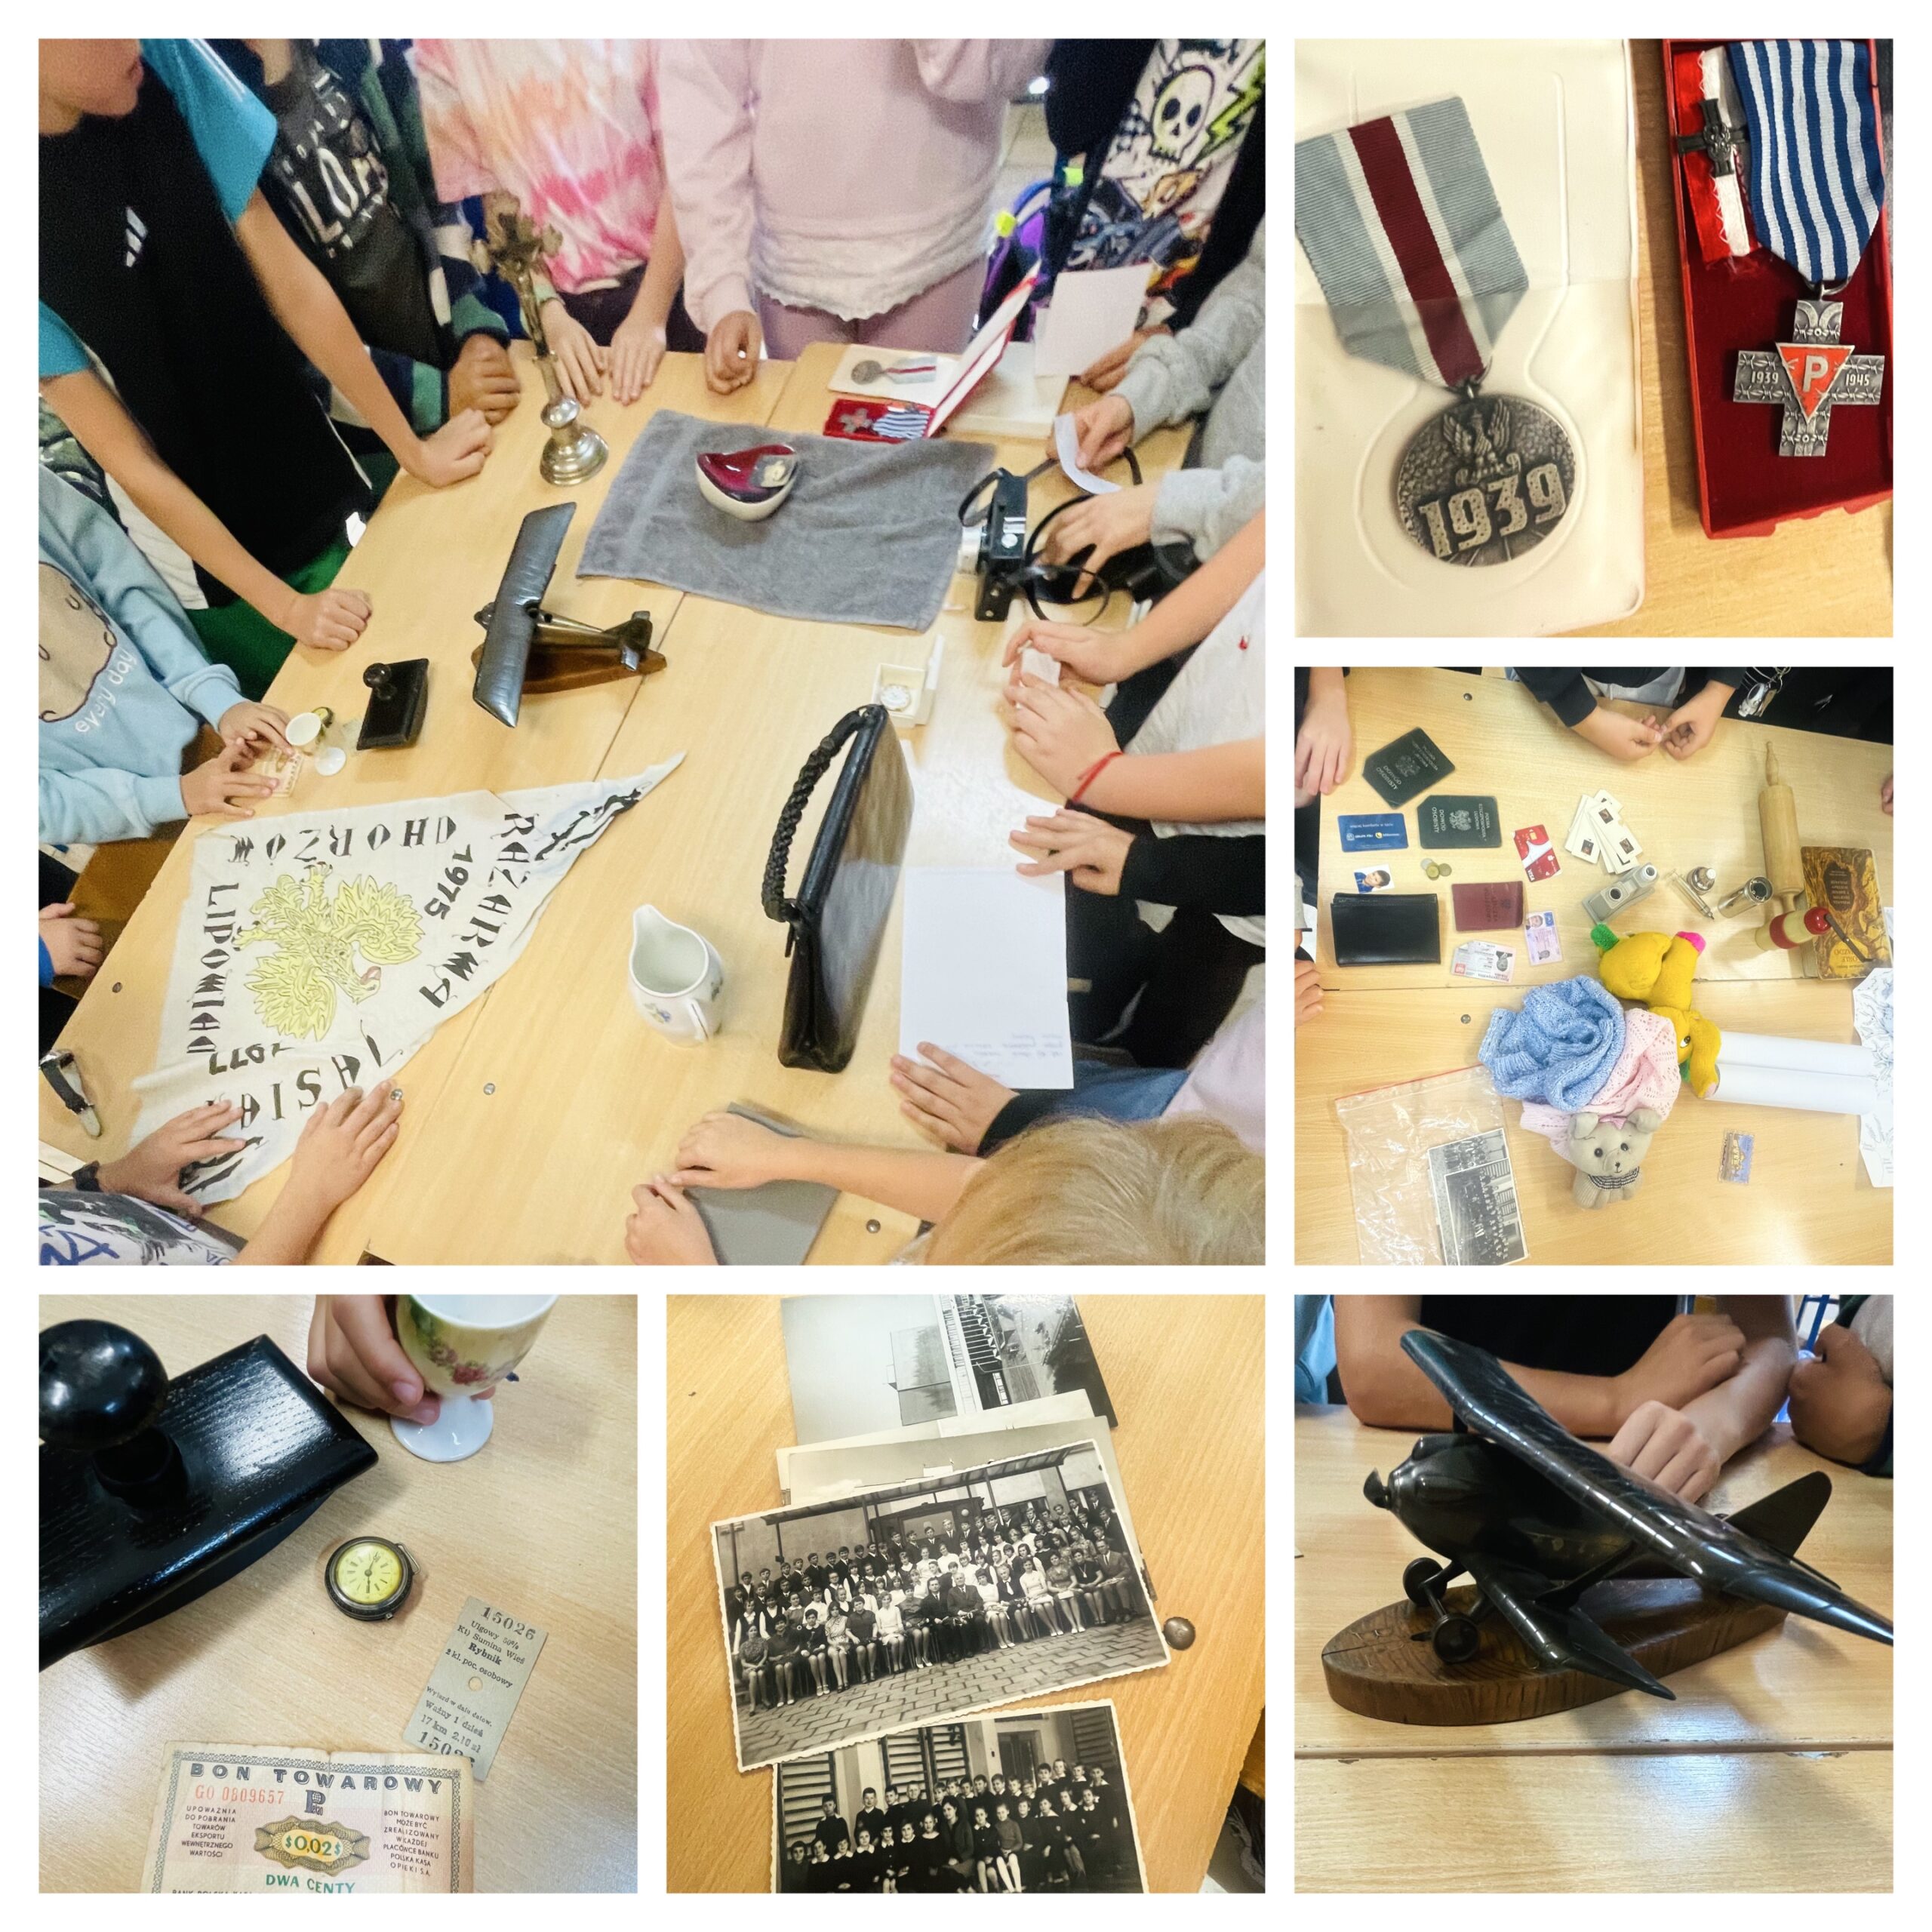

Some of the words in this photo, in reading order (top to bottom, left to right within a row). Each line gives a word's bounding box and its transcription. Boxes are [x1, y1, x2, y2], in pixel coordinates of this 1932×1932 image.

[1750, 370, 1780, 385] 1939
[1803, 355, 1829, 392] P
[1845, 373, 1871, 387] 1945
[1417, 462, 1567, 558] 1939
[75, 685, 116, 732] every
[107, 648, 137, 685] day
[1432, 807, 1440, 833] OSOBISTY
[424, 844, 473, 920] 1975
[1526, 866, 1535, 881] VISA
[471, 1620, 500, 1640] Ulgowy
[481, 1607, 536, 1641] 15026
[472, 1633, 502, 1653] Sumina
[468, 1642, 503, 1666] Rybnik
[451, 1651, 461, 1662] kl.
[462, 1658, 478, 1671] poc.
[479, 1666, 513, 1688] osobowy
[425, 1700, 452, 1720] Ważny
[454, 1716, 459, 1724] 1
[421, 1714, 433, 1725] 17
[432, 1721, 448, 1735] km
[190, 1763, 251, 1781] BON
[273, 1768, 442, 1794] TOWAROWY
[186, 1805, 236, 1815] UPOWAŻNIA
[198, 1814, 236, 1823] POBRANIA
[401, 1811, 439, 1822] TOWAROWY
[192, 1823, 226, 1832] TOWARÓW
[383, 1826, 439, 1840] ZREALIZOWANY
[414, 1821, 427, 1829] BYĆ
[181, 1840, 233, 1849] WEWNĘTRZNEGO
[191, 1832, 225, 1840] EKSPORTU
[189, 1850, 223, 1858] WARTOŚCI
[390, 1853, 414, 1863] POLSKA
[416, 1857, 431, 1867] KASA
[418, 1849, 439, 1859] BANKU
[266, 1874, 299, 1887] DWA
[306, 1878, 355, 1894] CENTY
